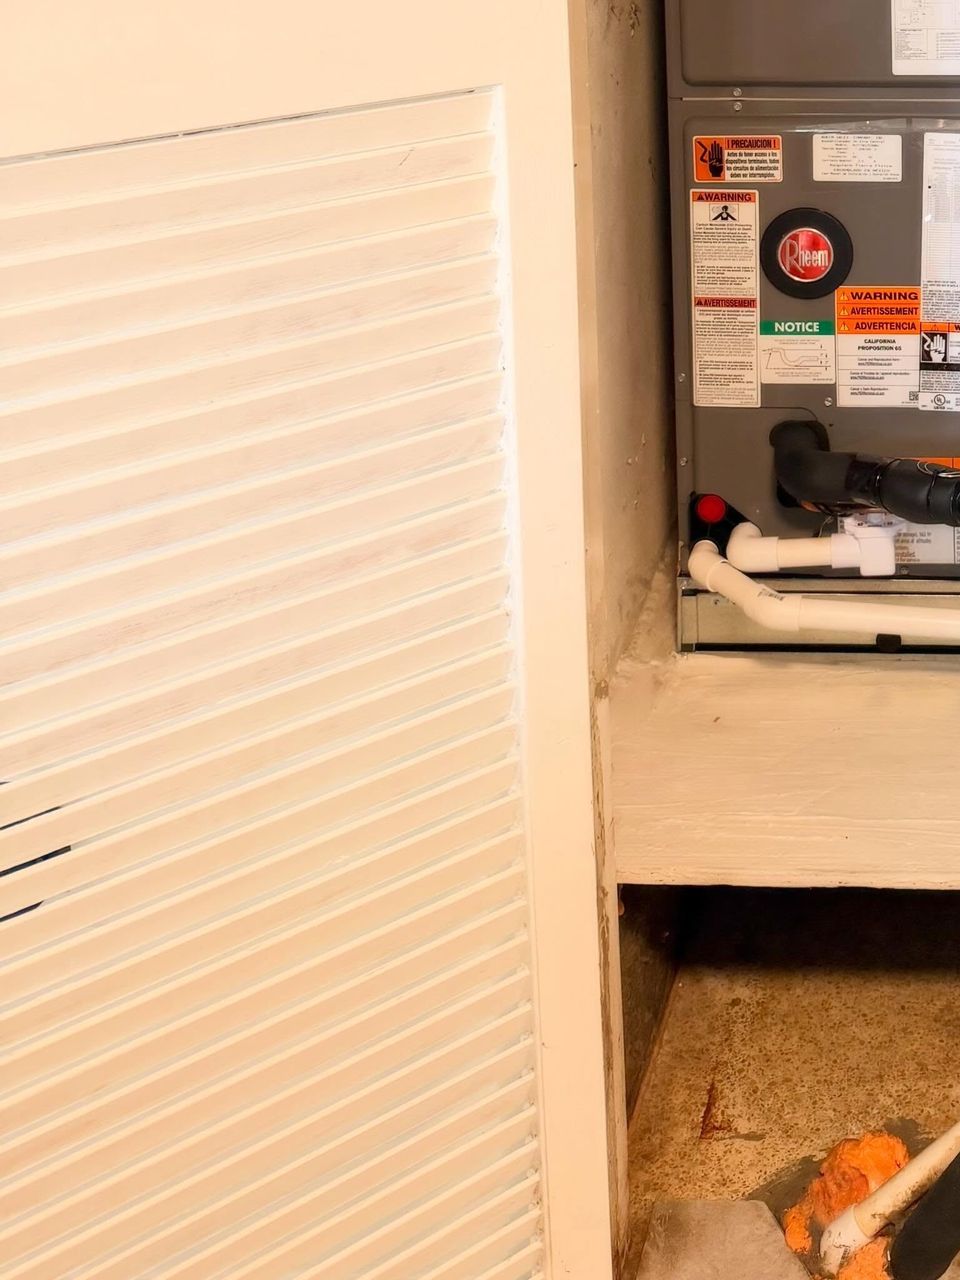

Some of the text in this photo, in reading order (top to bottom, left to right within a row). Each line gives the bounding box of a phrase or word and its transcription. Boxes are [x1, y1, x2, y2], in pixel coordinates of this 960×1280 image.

[704, 193, 752, 202] WARNING
[785, 238, 829, 273] Rheem
[851, 292, 918, 300] WARNING
[703, 299, 756, 308] AVERTISSEMENT
[850, 307, 919, 315] AVERTISSEMENT
[774, 322, 820, 332] NOTICE
[854, 322, 917, 330] ADVERTENCIA
